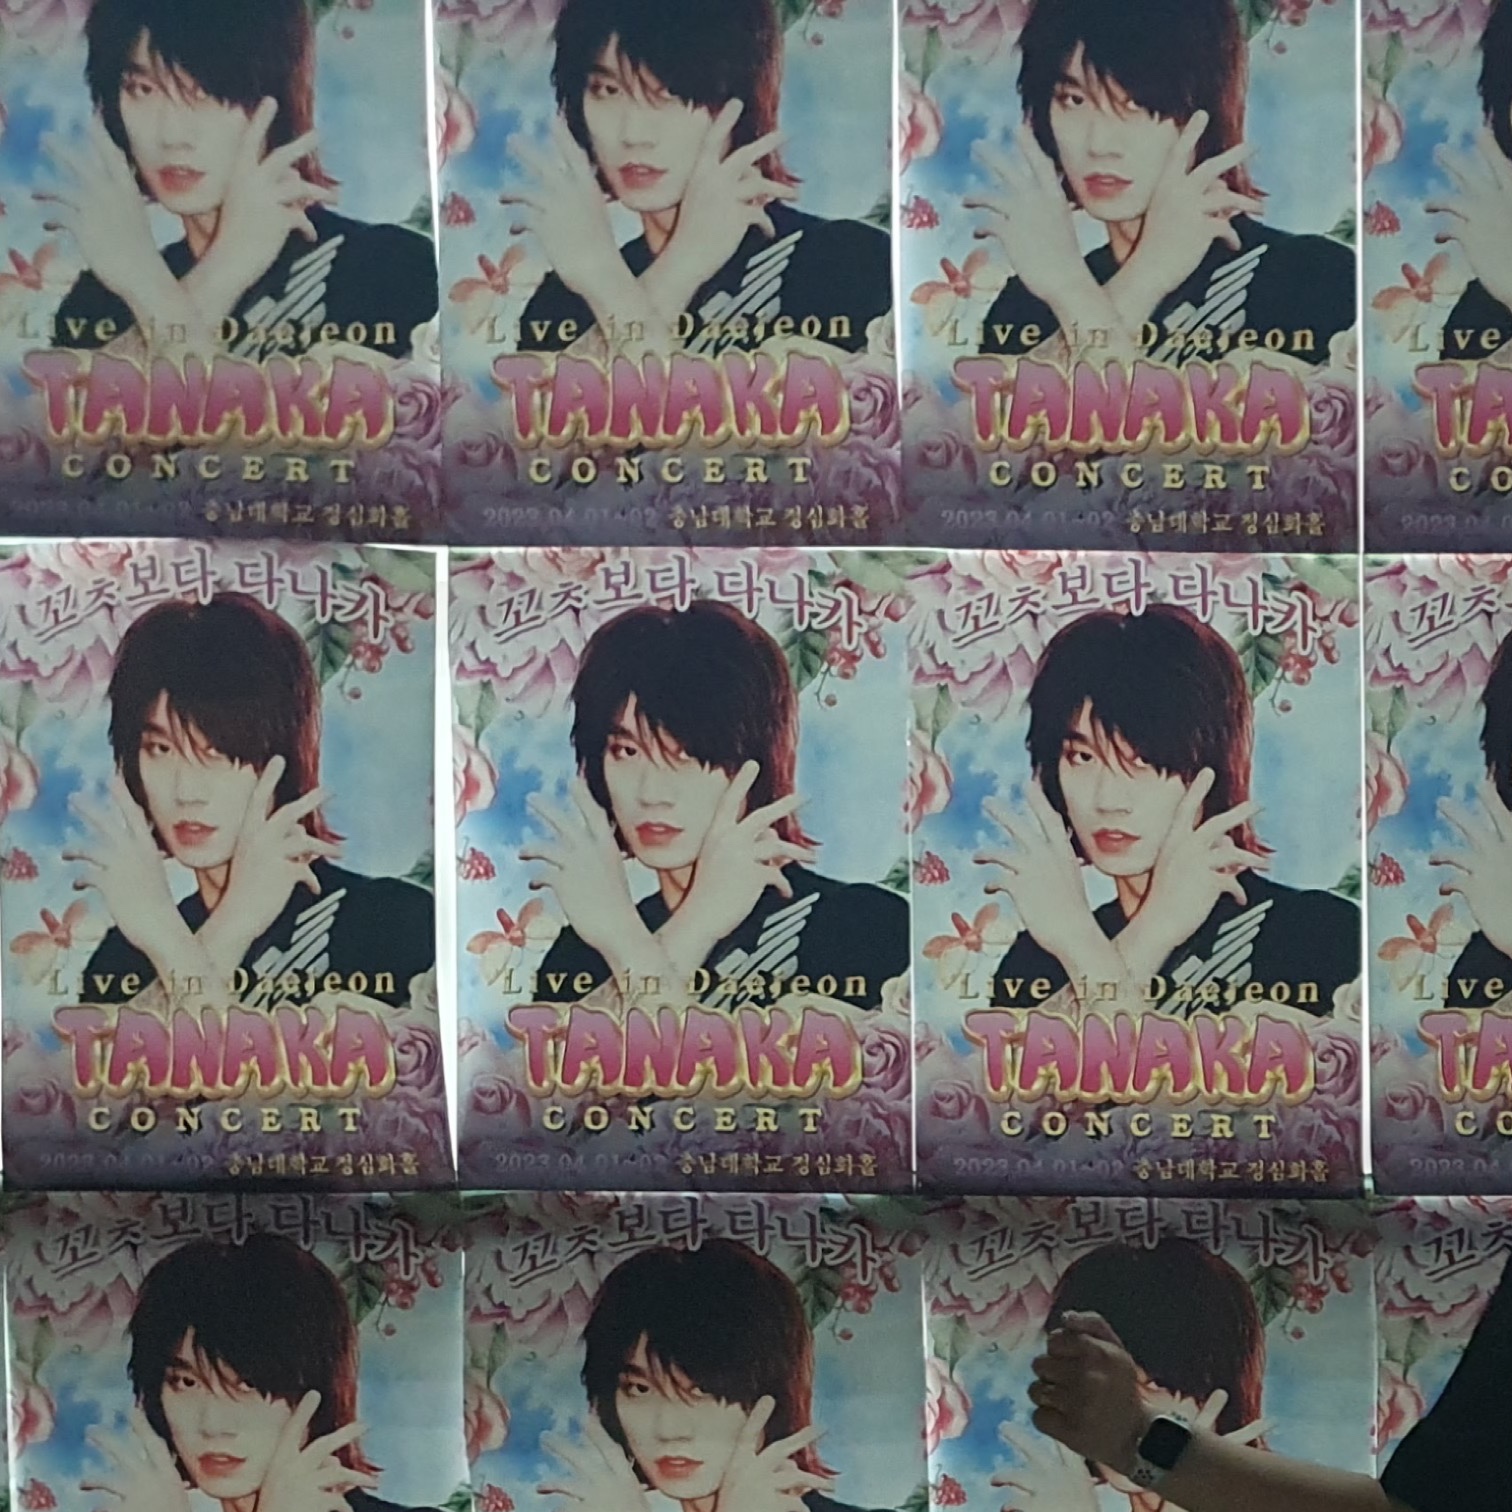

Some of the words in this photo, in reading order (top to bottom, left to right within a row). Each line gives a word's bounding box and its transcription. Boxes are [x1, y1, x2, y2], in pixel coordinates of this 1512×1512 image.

[19, 313, 116, 340] Live
[213, 315, 399, 347] Daejeon
[486, 314, 578, 343] Live
[670, 308, 852, 343] Daejeon
[948, 319, 1041, 347] Live
[1134, 321, 1314, 353] Daejeon
[1409, 324, 1501, 351] Live
[23, 348, 397, 448] TANAKA
[490, 345, 854, 451] TANAKA
[950, 354, 1312, 455] TANAKA
[62, 453, 353, 481] CONCERT
[530, 454, 812, 486] CONCERT
[988, 460, 1270, 490] CONCERT
[52, 969, 140, 996] Live
[226, 965, 397, 998] Daejeon
[502, 968, 594, 994] Live
[687, 968, 867, 998] Daejeon
[960, 973, 1050, 999] Live
[1143, 974, 1320, 1005] Daejeon
[1414, 974, 1505, 1001] Live
[56, 999, 399, 1101] TANAKA
[505, 1002, 864, 1098] TANAKA
[964, 1008, 1317, 1105] TANAKA
[88, 1104, 362, 1135] CONCERT
[542, 1105, 822, 1132] CONCERT
[1000, 1110, 1276, 1138] CONCERT
